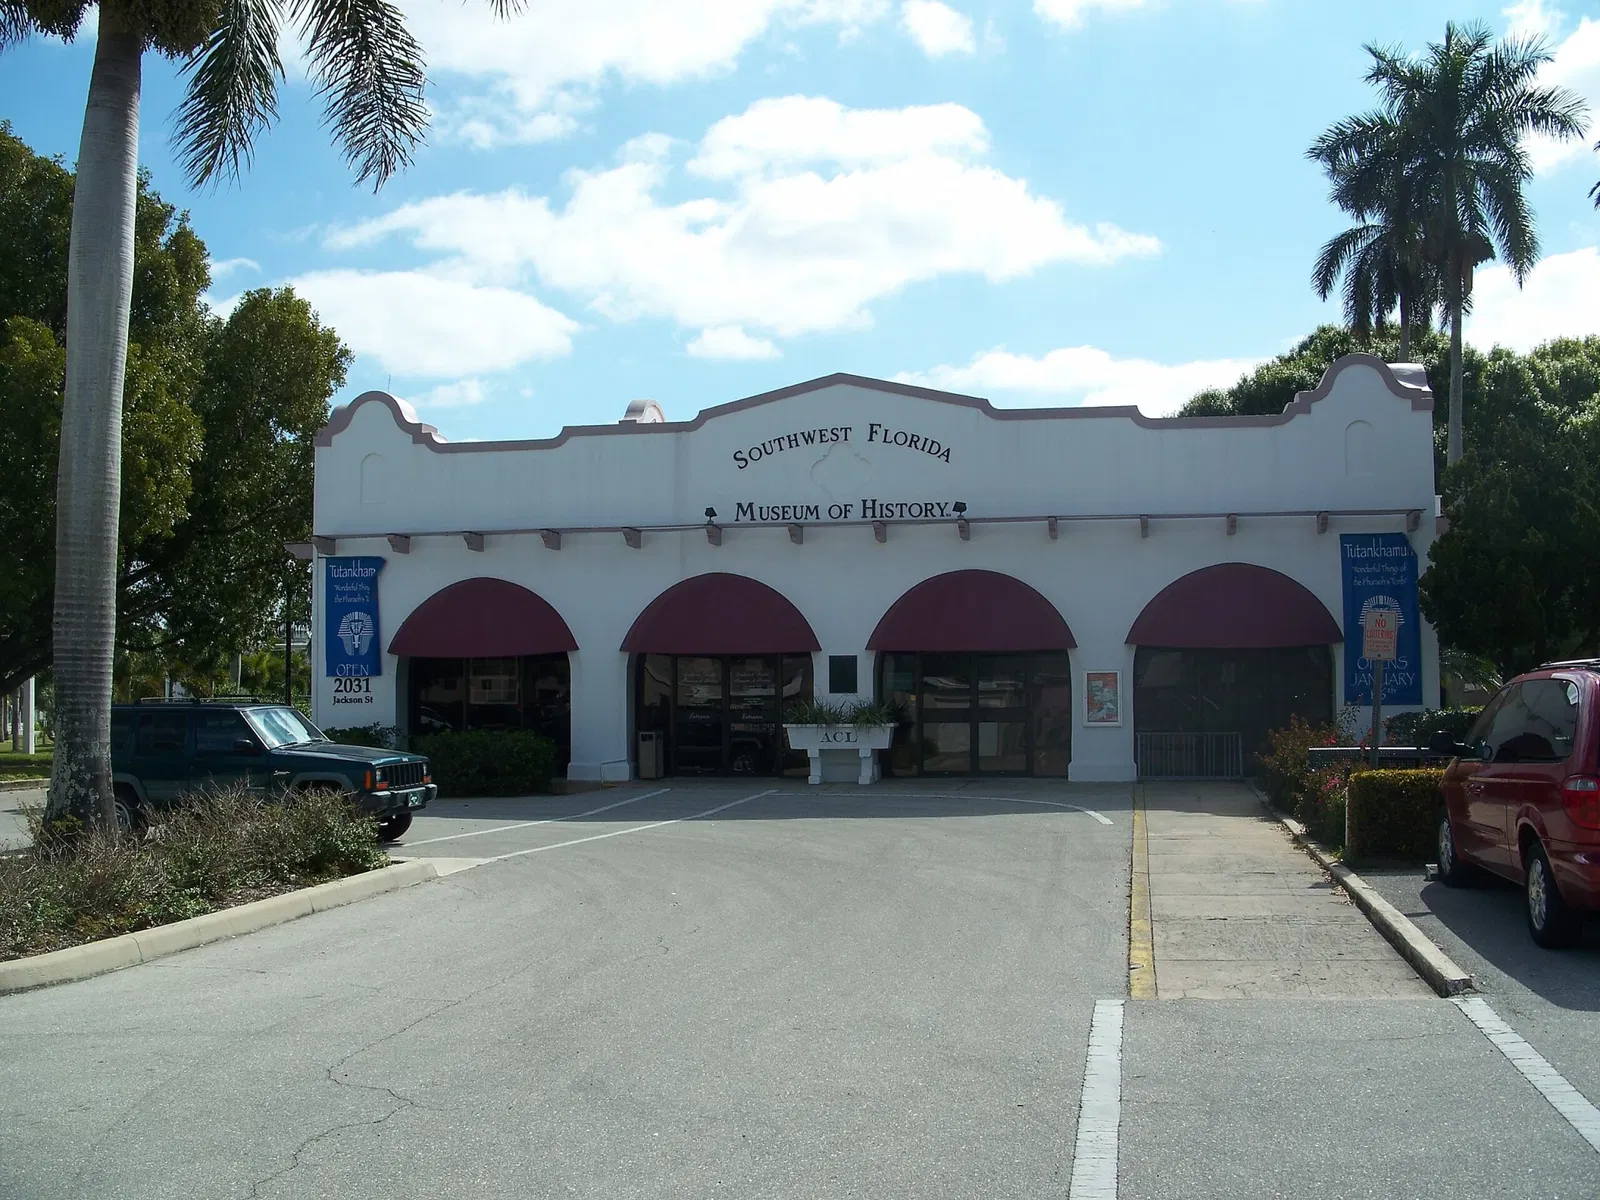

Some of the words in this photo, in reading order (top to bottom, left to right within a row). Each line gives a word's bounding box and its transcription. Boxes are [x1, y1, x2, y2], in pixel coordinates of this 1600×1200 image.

[733, 427, 852, 469] SOUTHWEST
[868, 423, 951, 463] FLORIDA
[734, 502, 821, 522] MUSEUM
[828, 503, 853, 519] OF
[1375, 619, 1387, 628] NO
[334, 677, 372, 693] 2031
[333, 695, 363, 706] Jackson
[364, 696, 373, 704] St
[820, 731, 858, 744] ACL
